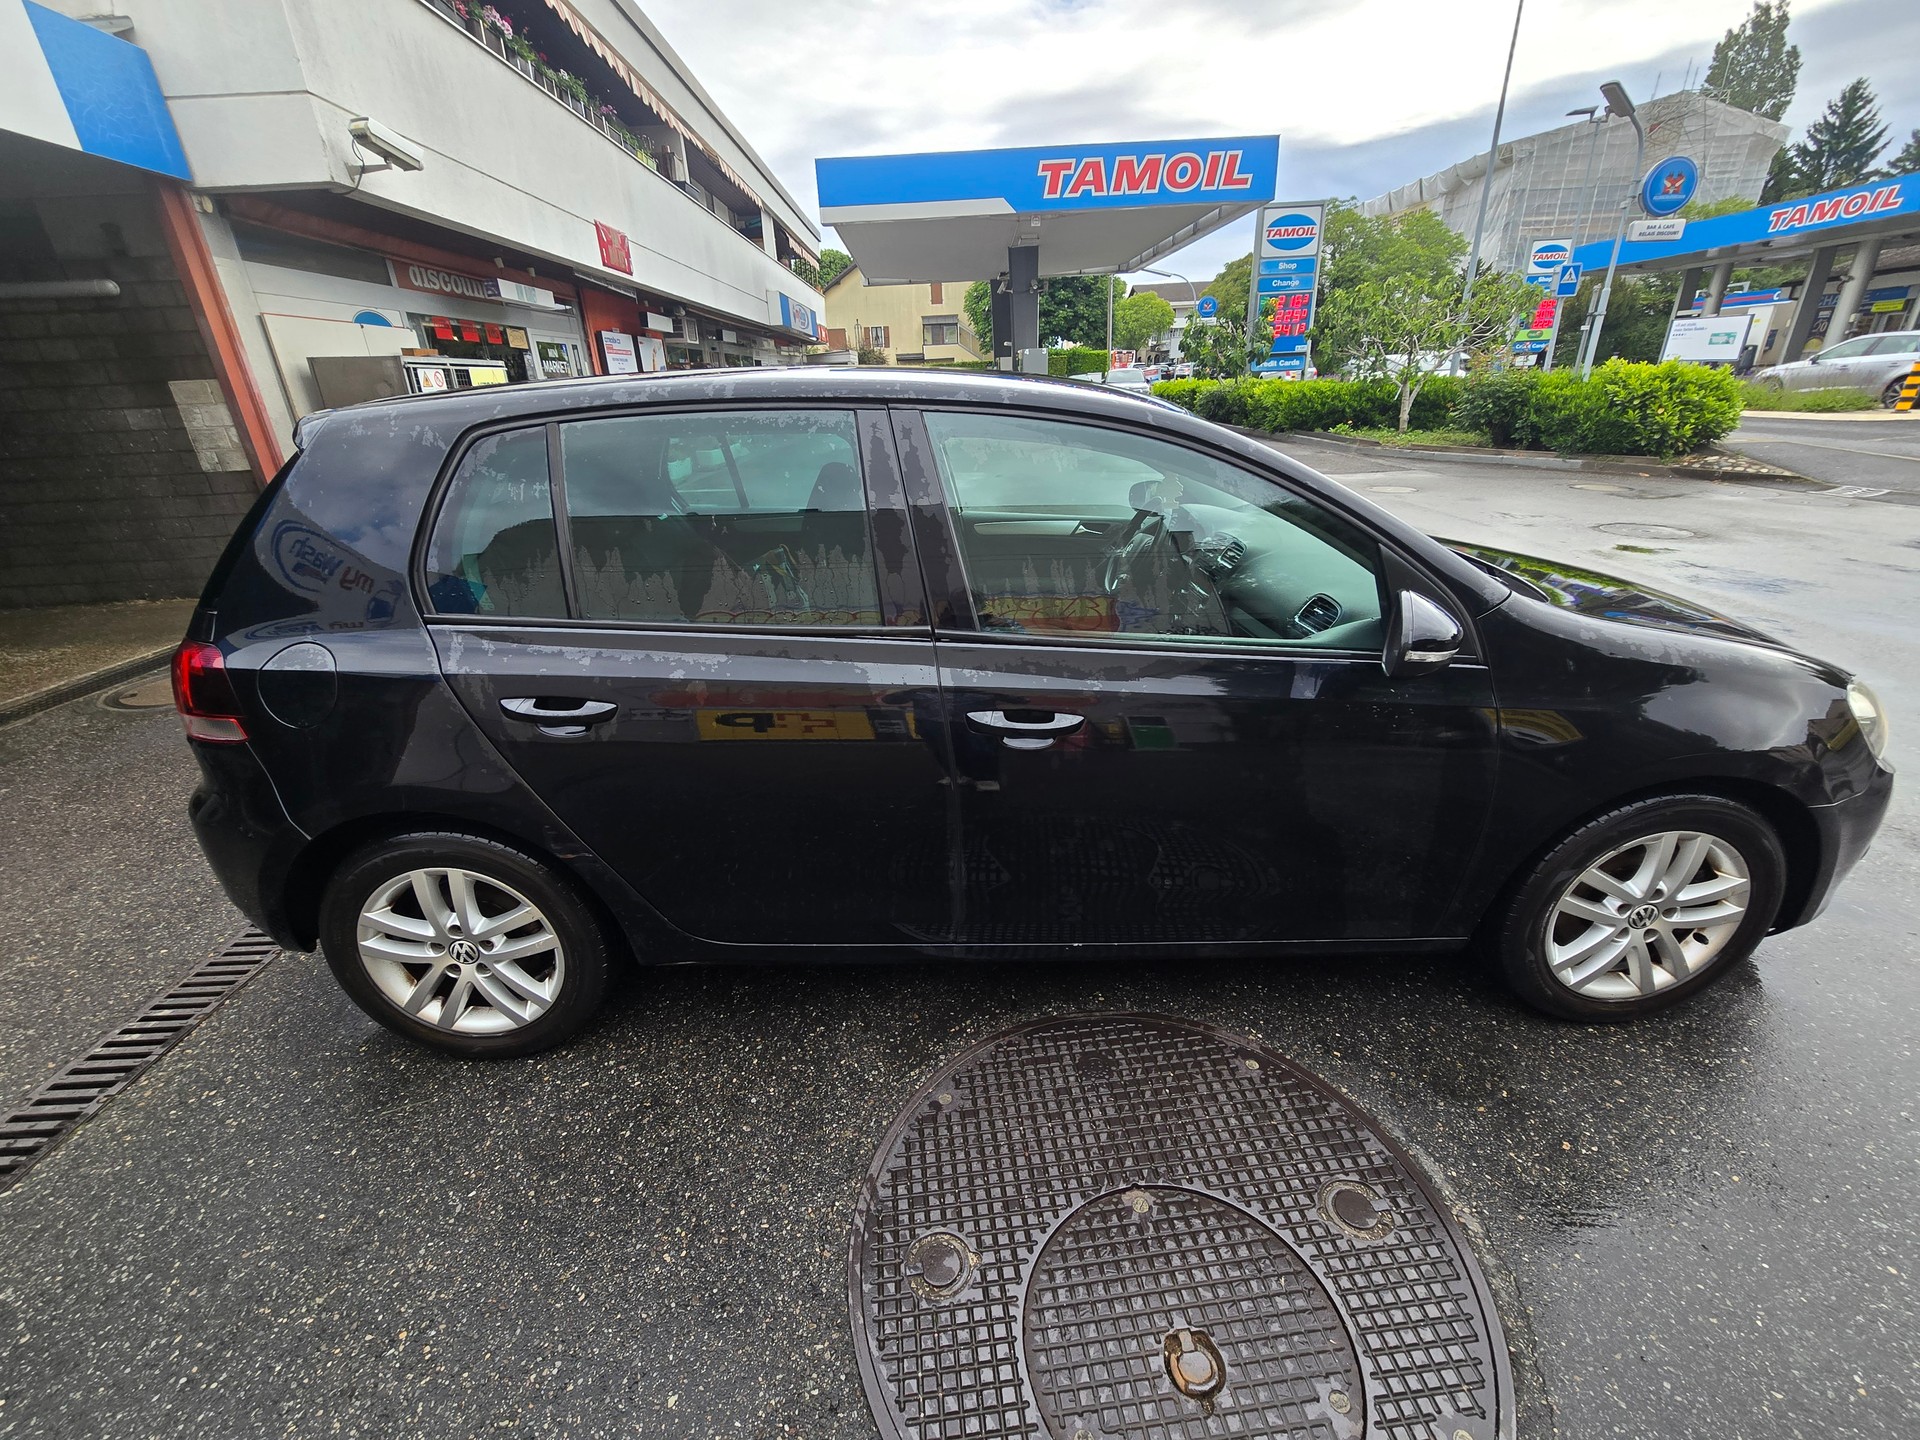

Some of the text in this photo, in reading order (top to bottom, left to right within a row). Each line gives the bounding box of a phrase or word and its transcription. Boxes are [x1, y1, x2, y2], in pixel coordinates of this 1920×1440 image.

[1037, 150, 1253, 199] TAMOIL
[1768, 184, 1904, 233] TAMOIL
[1266, 226, 1318, 238] TAMOIL
[1532, 252, 1568, 260] TAMOIL
[1278, 262, 1297, 270] Shop
[1272, 279, 1300, 288] Change
